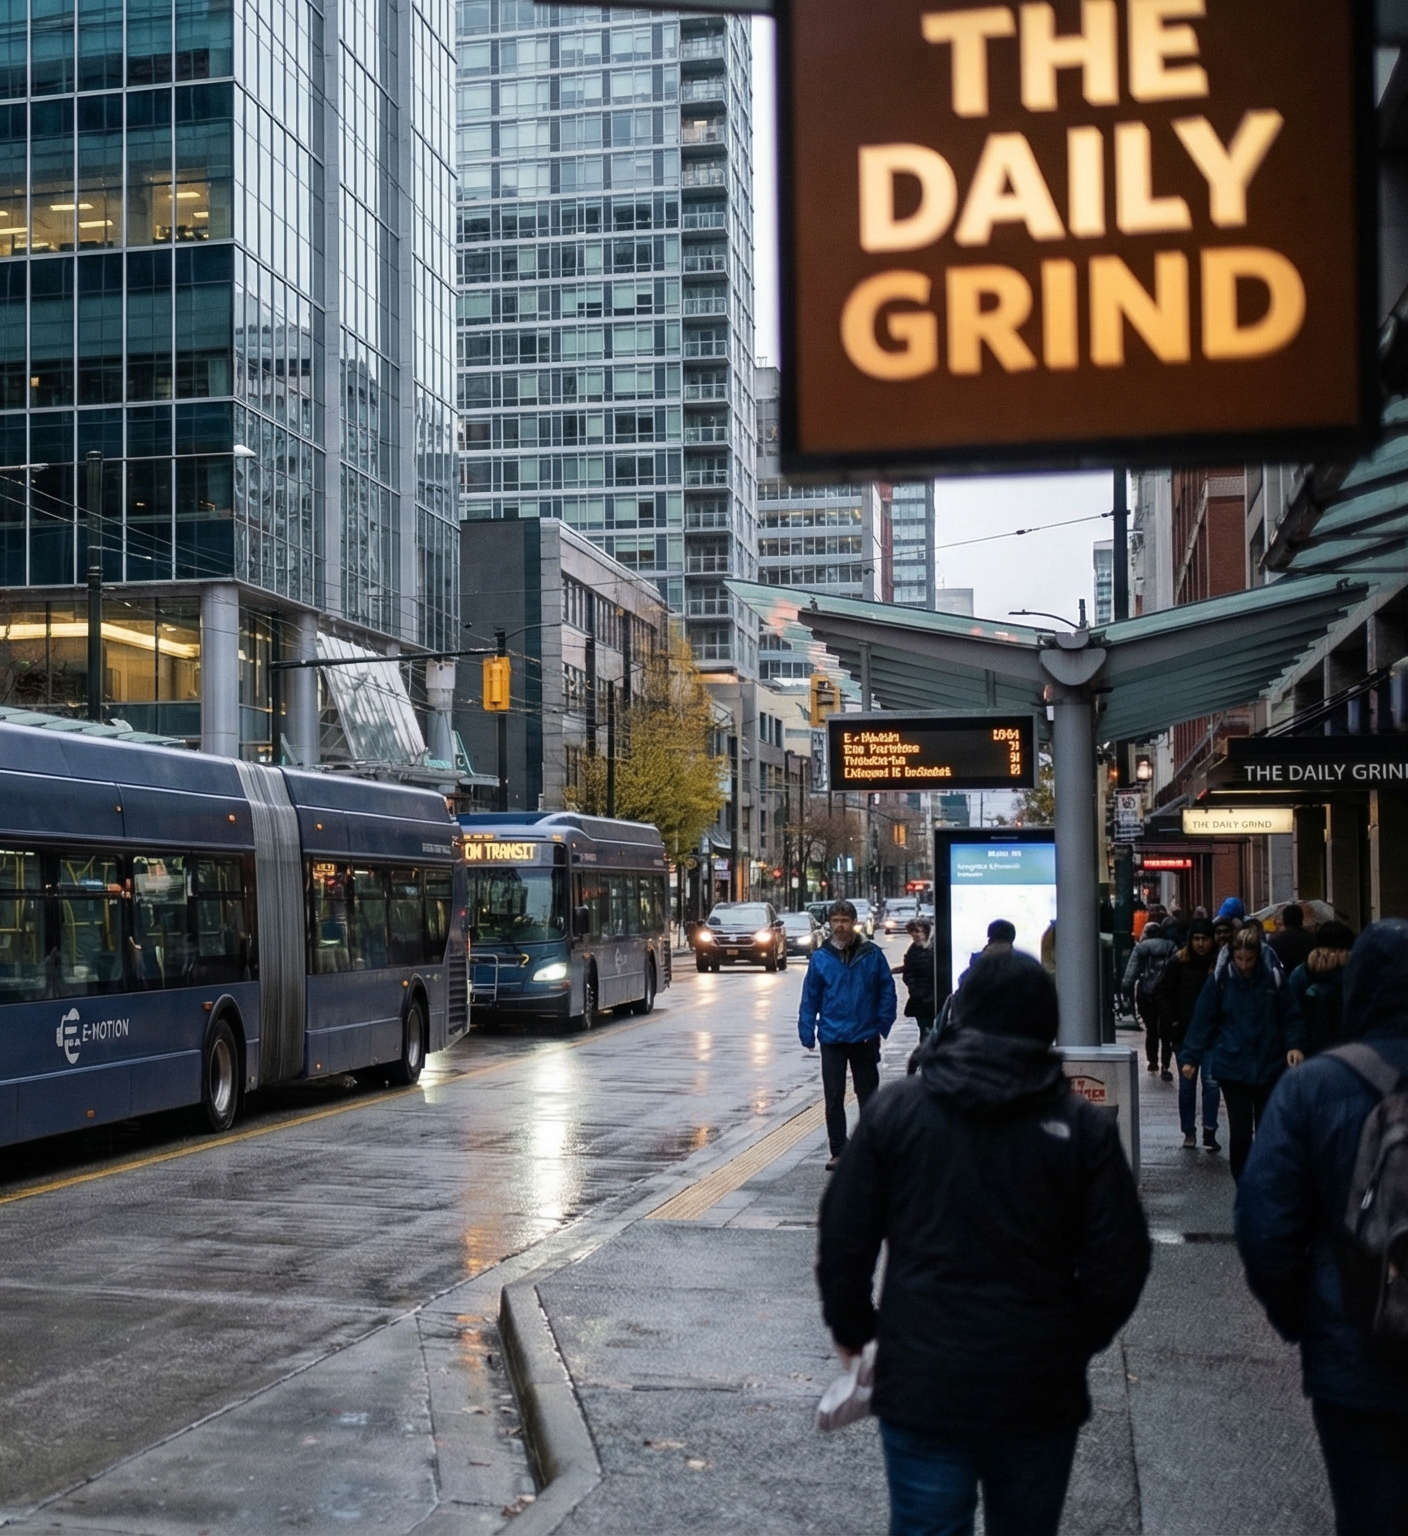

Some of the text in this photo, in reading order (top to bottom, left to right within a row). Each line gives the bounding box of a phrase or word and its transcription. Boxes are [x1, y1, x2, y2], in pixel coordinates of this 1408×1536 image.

[921, 0, 1210, 118] THE
[857, 108, 1285, 253] DAILY
[840, 244, 1307, 382] GRIND
[1244, 763, 1408, 781] THE DAILY GRIN
[484, 842, 537, 860] TRANSIT
[82, 1018, 129, 1042] E-MOTION
